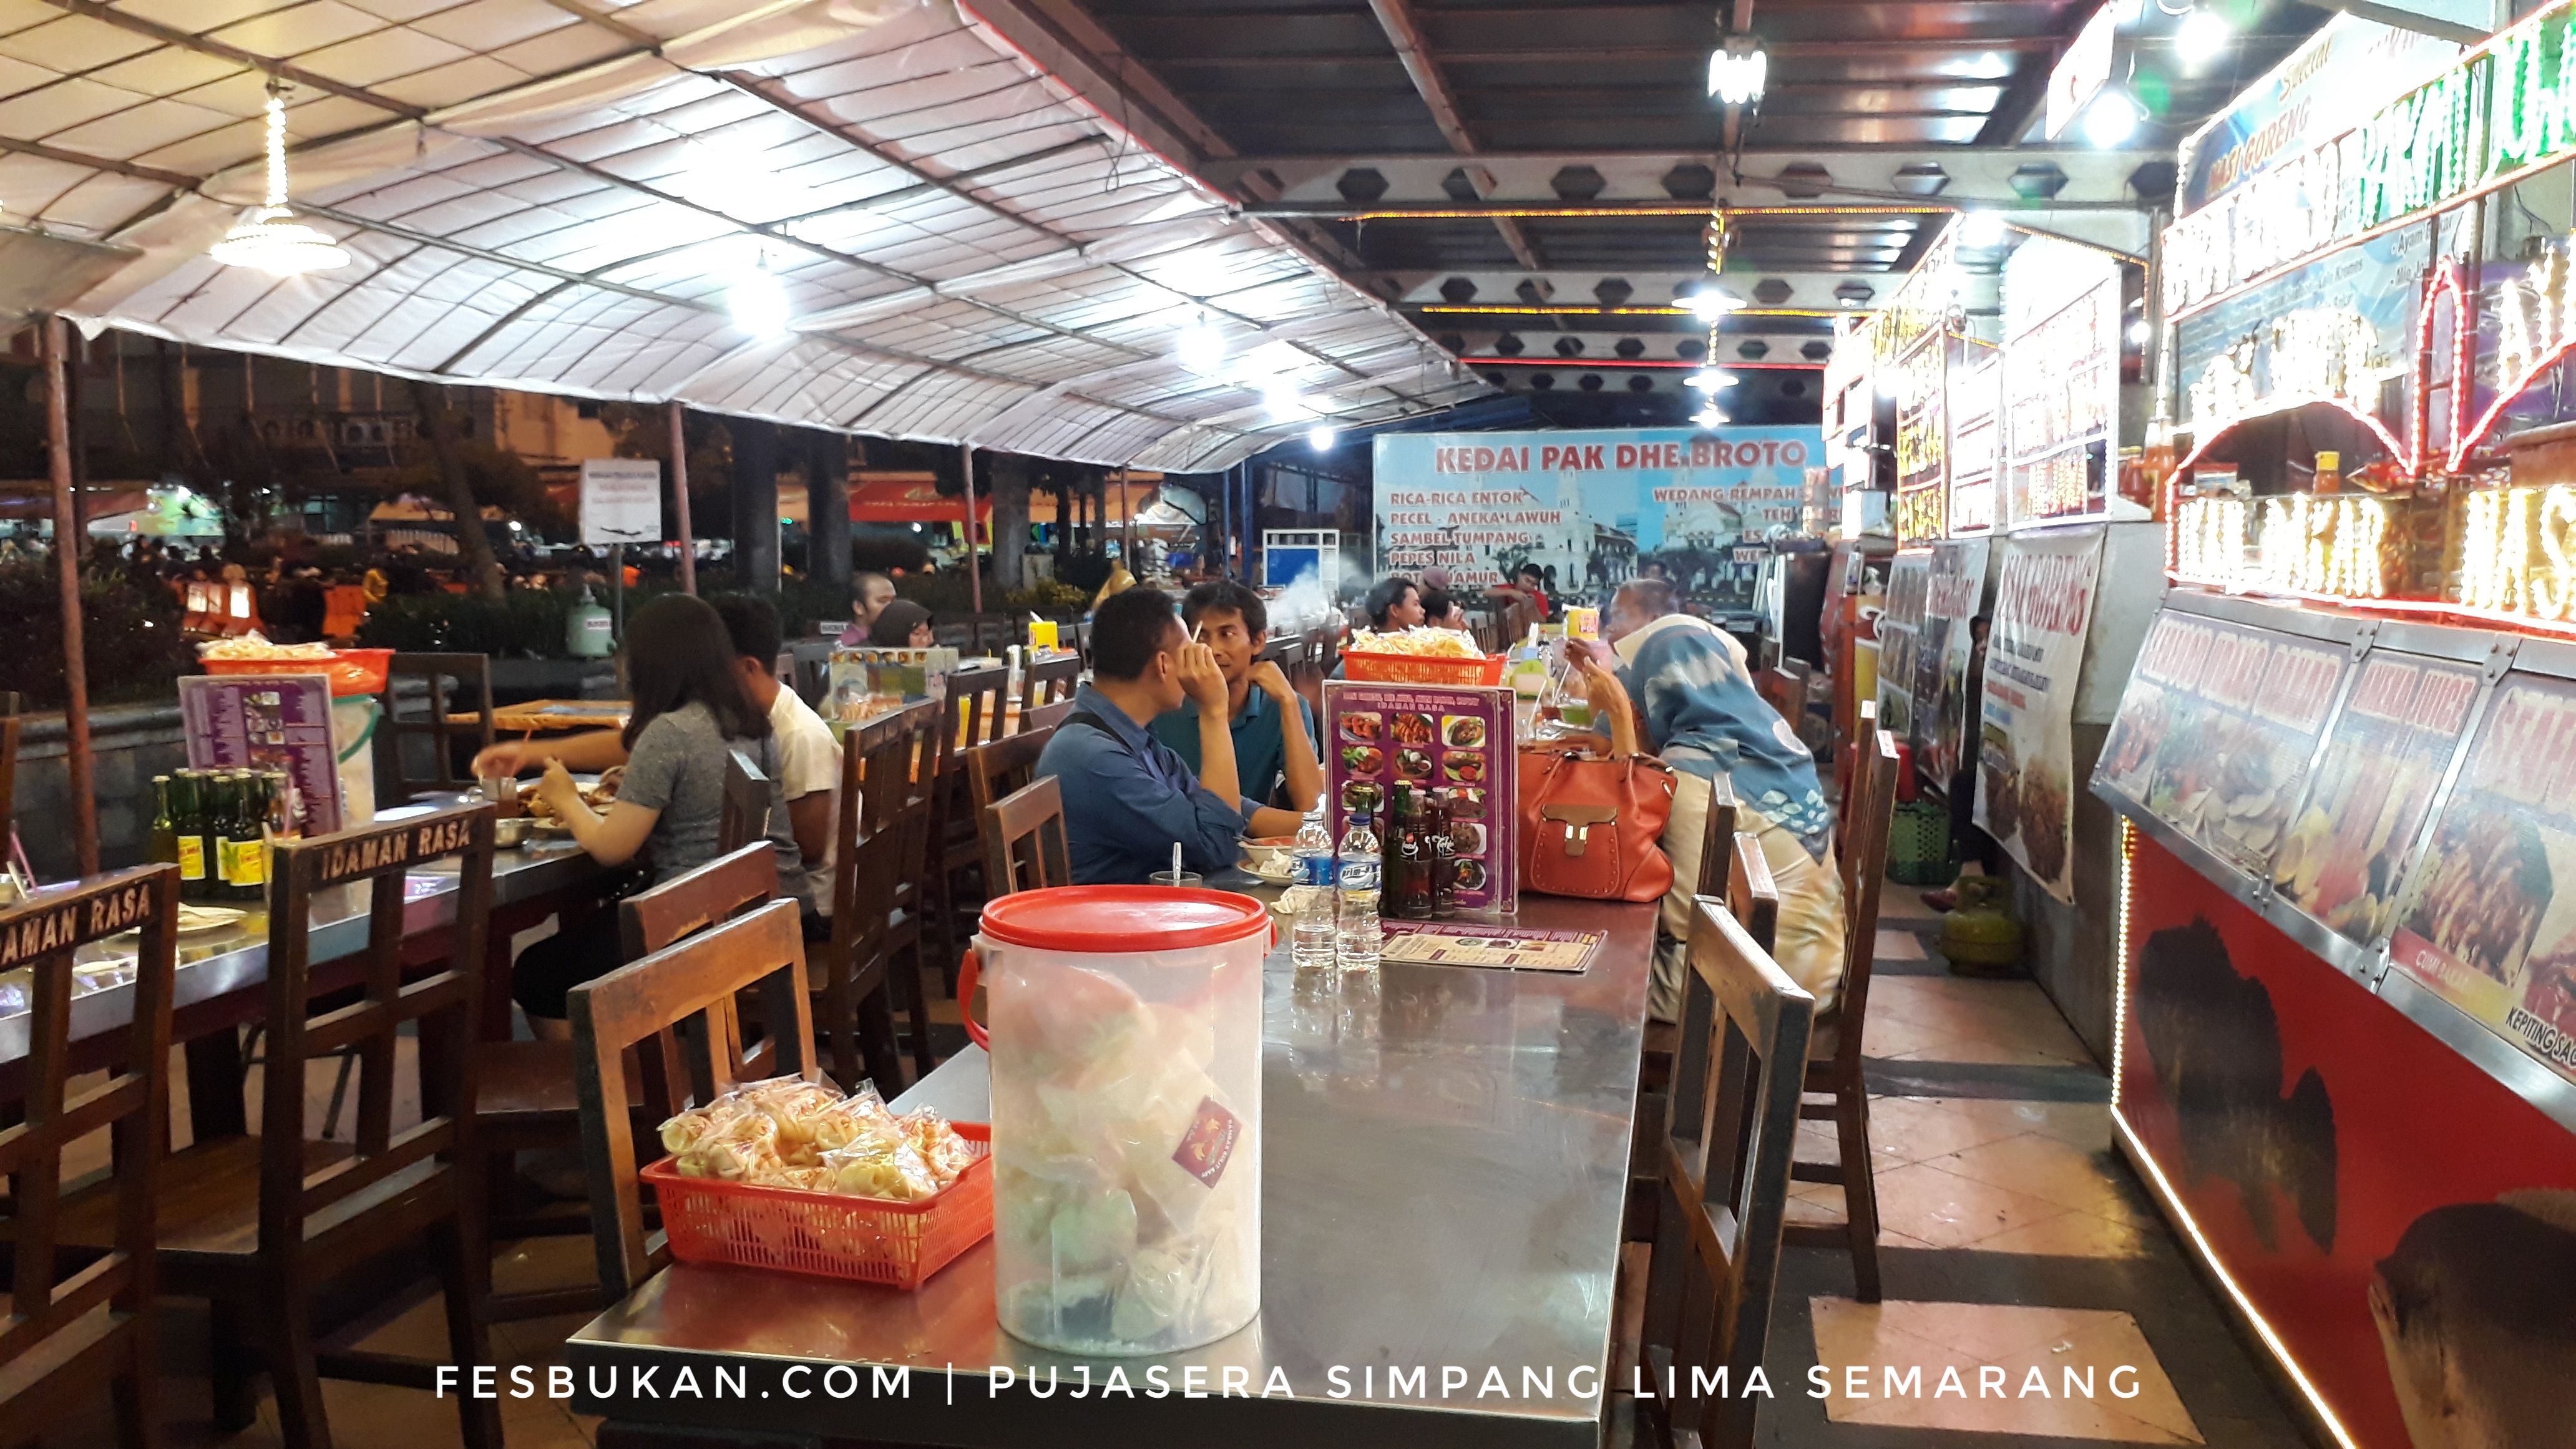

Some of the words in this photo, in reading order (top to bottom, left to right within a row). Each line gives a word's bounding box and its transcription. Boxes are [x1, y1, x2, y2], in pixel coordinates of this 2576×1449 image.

[2243, 94, 2312, 172] GORENG
[1436, 446, 1529, 472] KEDAI
[1541, 444, 1604, 471] PAK
[1617, 442, 1680, 469] DHE
[1689, 439, 1808, 467] BROTO
[1390, 492, 1466, 506] RICA-RICA
[1471, 490, 1525, 505] ENTOK
[1654, 487, 1725, 502] WEDANG
[1729, 487, 1796, 501] REMPAH
[1390, 512, 1433, 525] PECEL
[1447, 512, 1500, 525] ANEKA
[1505, 510, 1562, 524] LAWUH
[1762, 508, 1795, 522] TEH
[1390, 532, 1450, 545] SAMBEL
[1454, 531, 1530, 545] TUMPANG
[1389, 551, 1435, 565] PEPES
[1437, 550, 1476, 565] NILA
[322, 832, 409, 881] IDAMAN
[417, 819, 471, 857] RASA
[1, 905, 79, 966] AMAN
[89, 882, 152, 935] RASA
[2505, 1005, 2557, 1050] KEPITING
